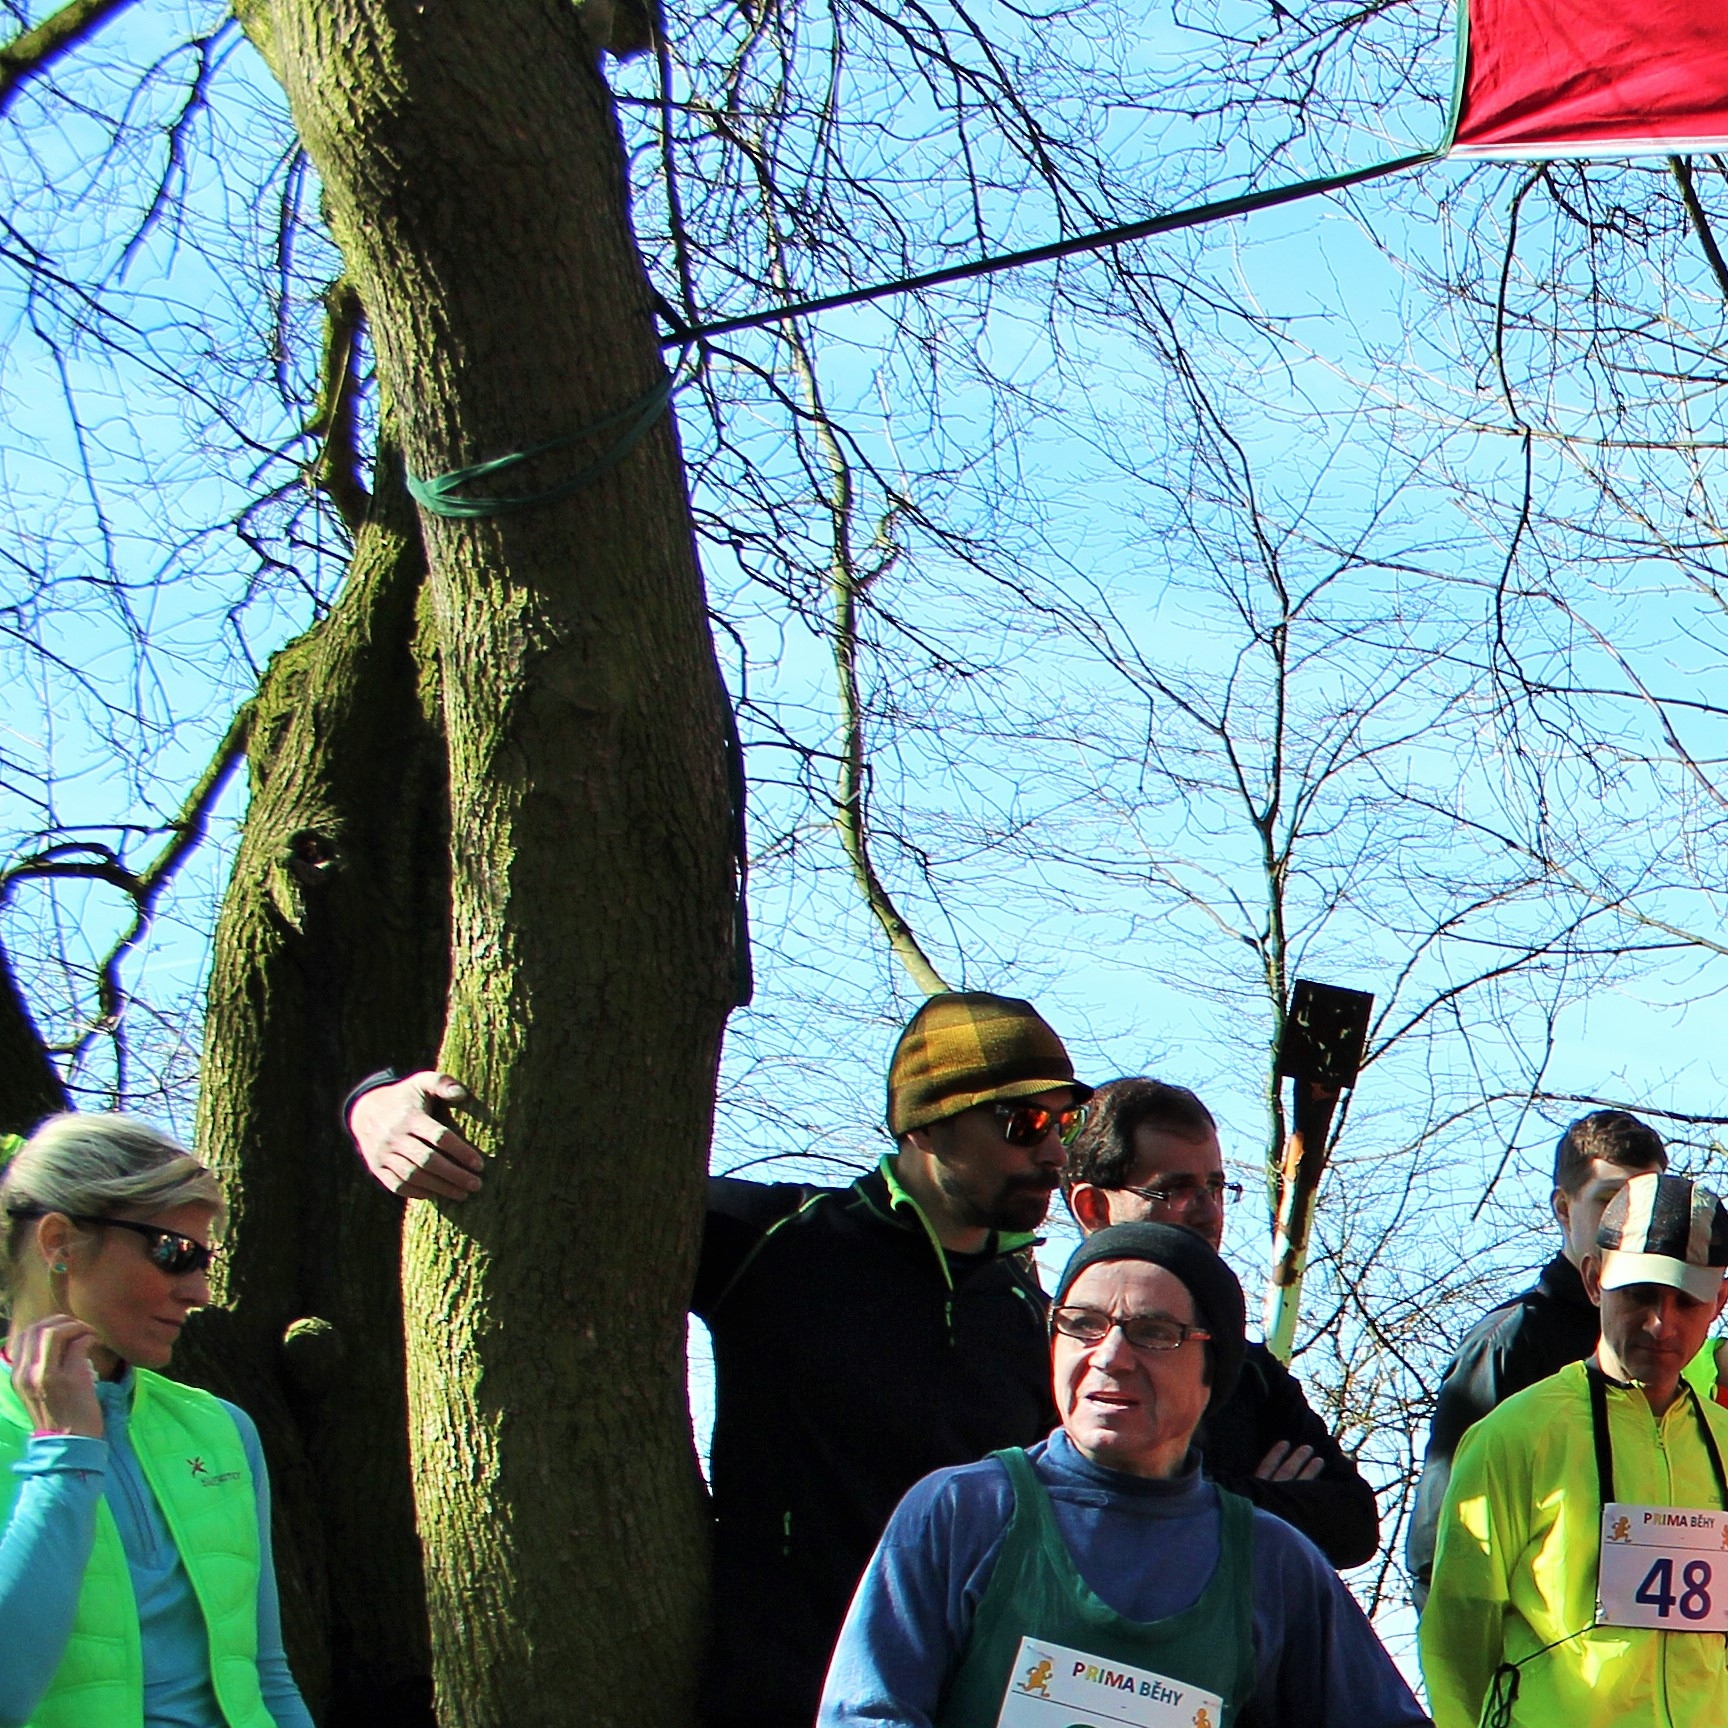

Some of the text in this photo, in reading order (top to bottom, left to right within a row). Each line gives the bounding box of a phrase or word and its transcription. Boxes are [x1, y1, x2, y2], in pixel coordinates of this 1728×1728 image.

[1643, 1512, 1715, 1529] PRIMA BĚHY
[1635, 1558, 1712, 1620] 48
[1072, 1661, 1184, 1707] PRIMA BĚHY
